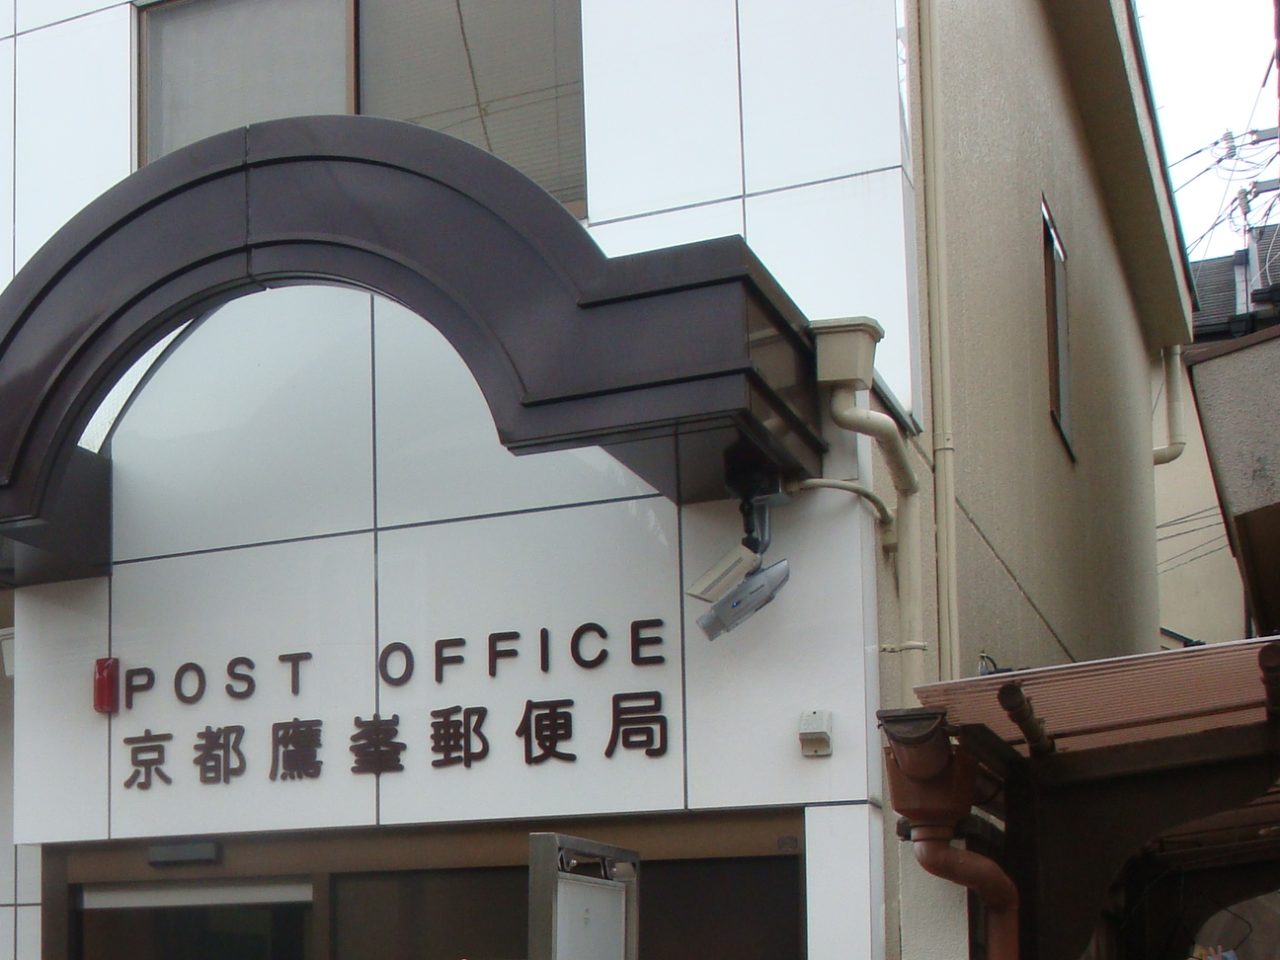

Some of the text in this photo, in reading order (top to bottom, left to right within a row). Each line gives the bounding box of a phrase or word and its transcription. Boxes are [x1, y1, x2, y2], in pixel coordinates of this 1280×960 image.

[124, 618, 665, 710] POST OFFICE
[123, 690, 669, 792] 京都鷹峯郵便局
